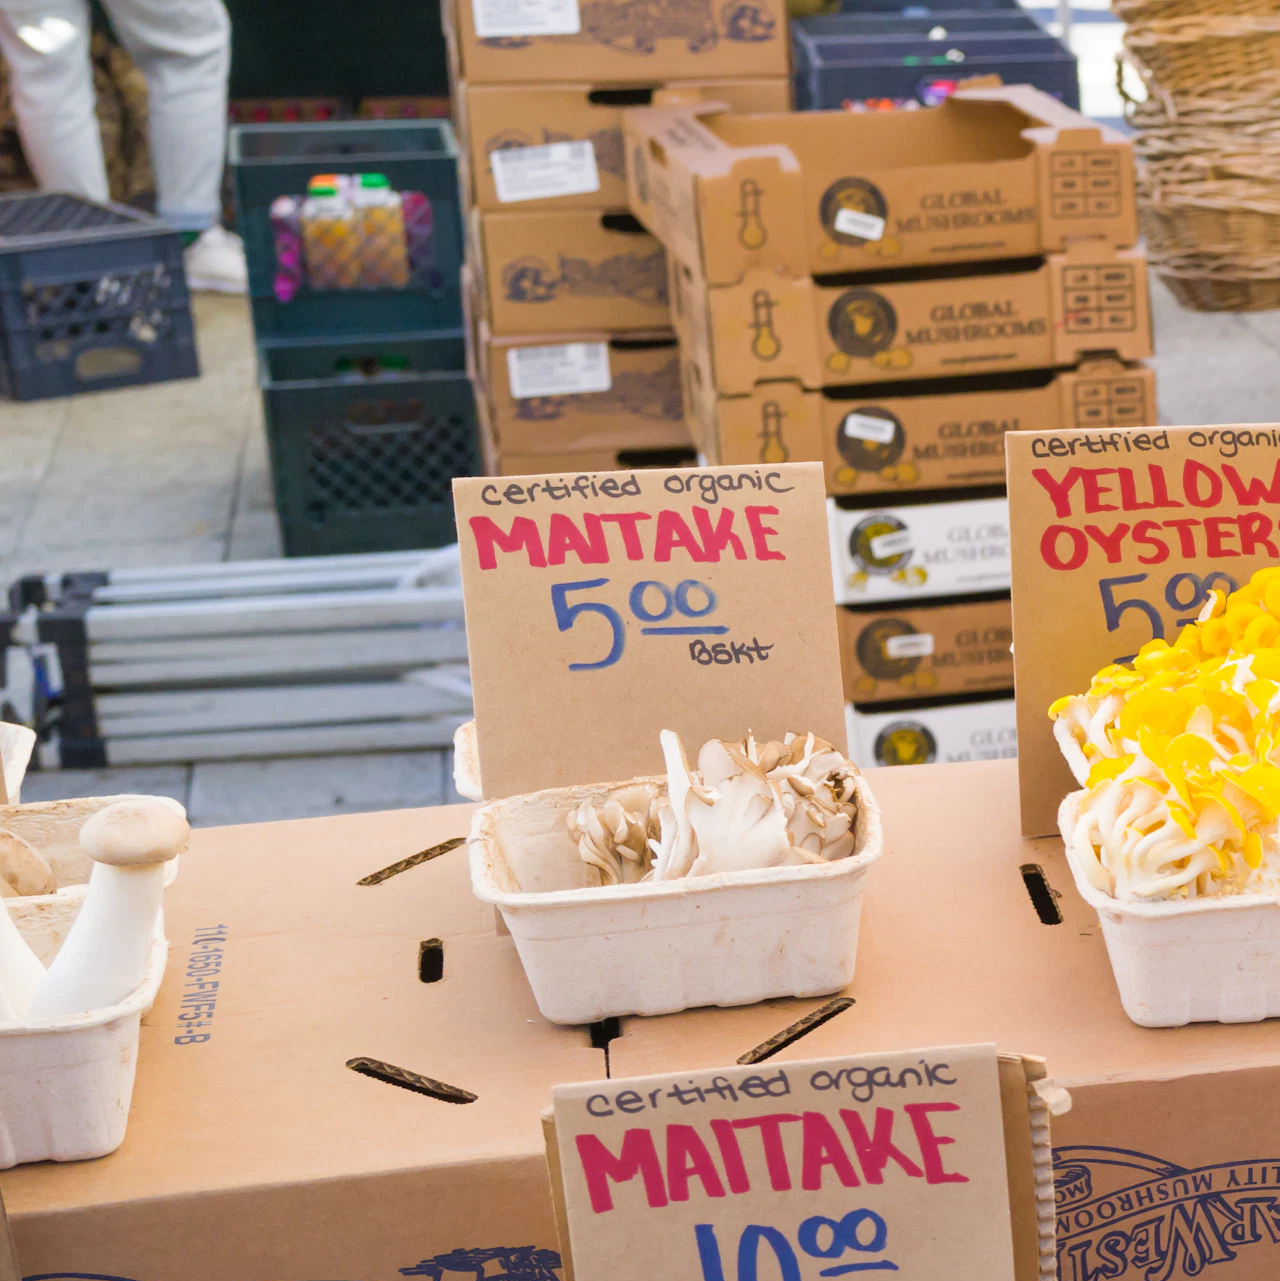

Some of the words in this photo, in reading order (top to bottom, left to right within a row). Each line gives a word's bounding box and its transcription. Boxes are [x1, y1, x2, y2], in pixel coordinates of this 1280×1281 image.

[930, 300, 1018, 323] GLOBAL
[1031, 431, 1171, 458] certified
[481, 473, 641, 506] certified
[663, 470, 795, 504] organic
[468, 505, 786, 570] MAITAKE
[585, 1069, 790, 1117] certified
[810, 1059, 958, 1103] organic
[574, 1102, 970, 1214] MAITAKE
